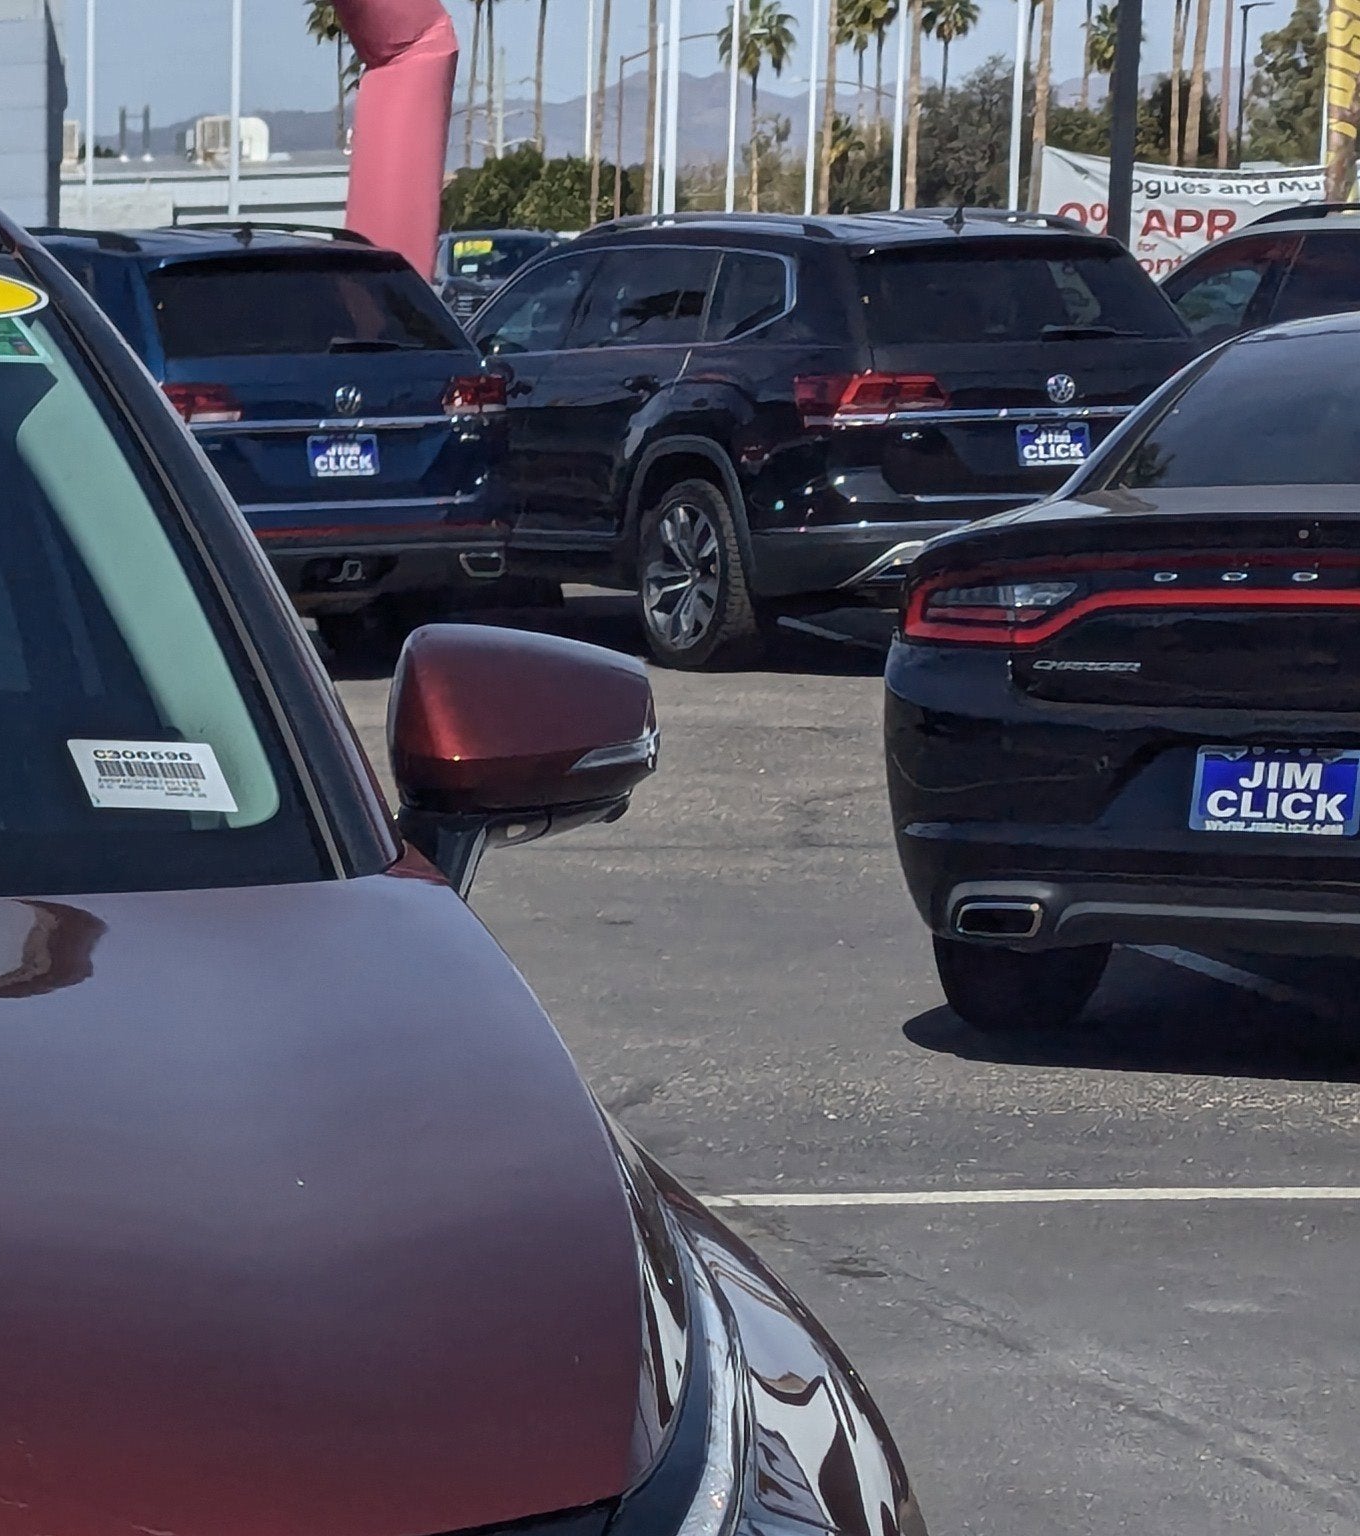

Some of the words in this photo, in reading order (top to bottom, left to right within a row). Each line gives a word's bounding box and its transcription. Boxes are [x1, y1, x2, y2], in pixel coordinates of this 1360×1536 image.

[1132, 179, 1211, 199] ogues
[1218, 180, 1270, 195] and
[1279, 181, 1321, 194] Mu
[1141, 208, 1237, 241] APR
[314, 454, 374, 471] CLICK
[1023, 443, 1084, 459] CLICK
[1238, 761, 1324, 791] JIM
[1206, 789, 1348, 822] CLICK
